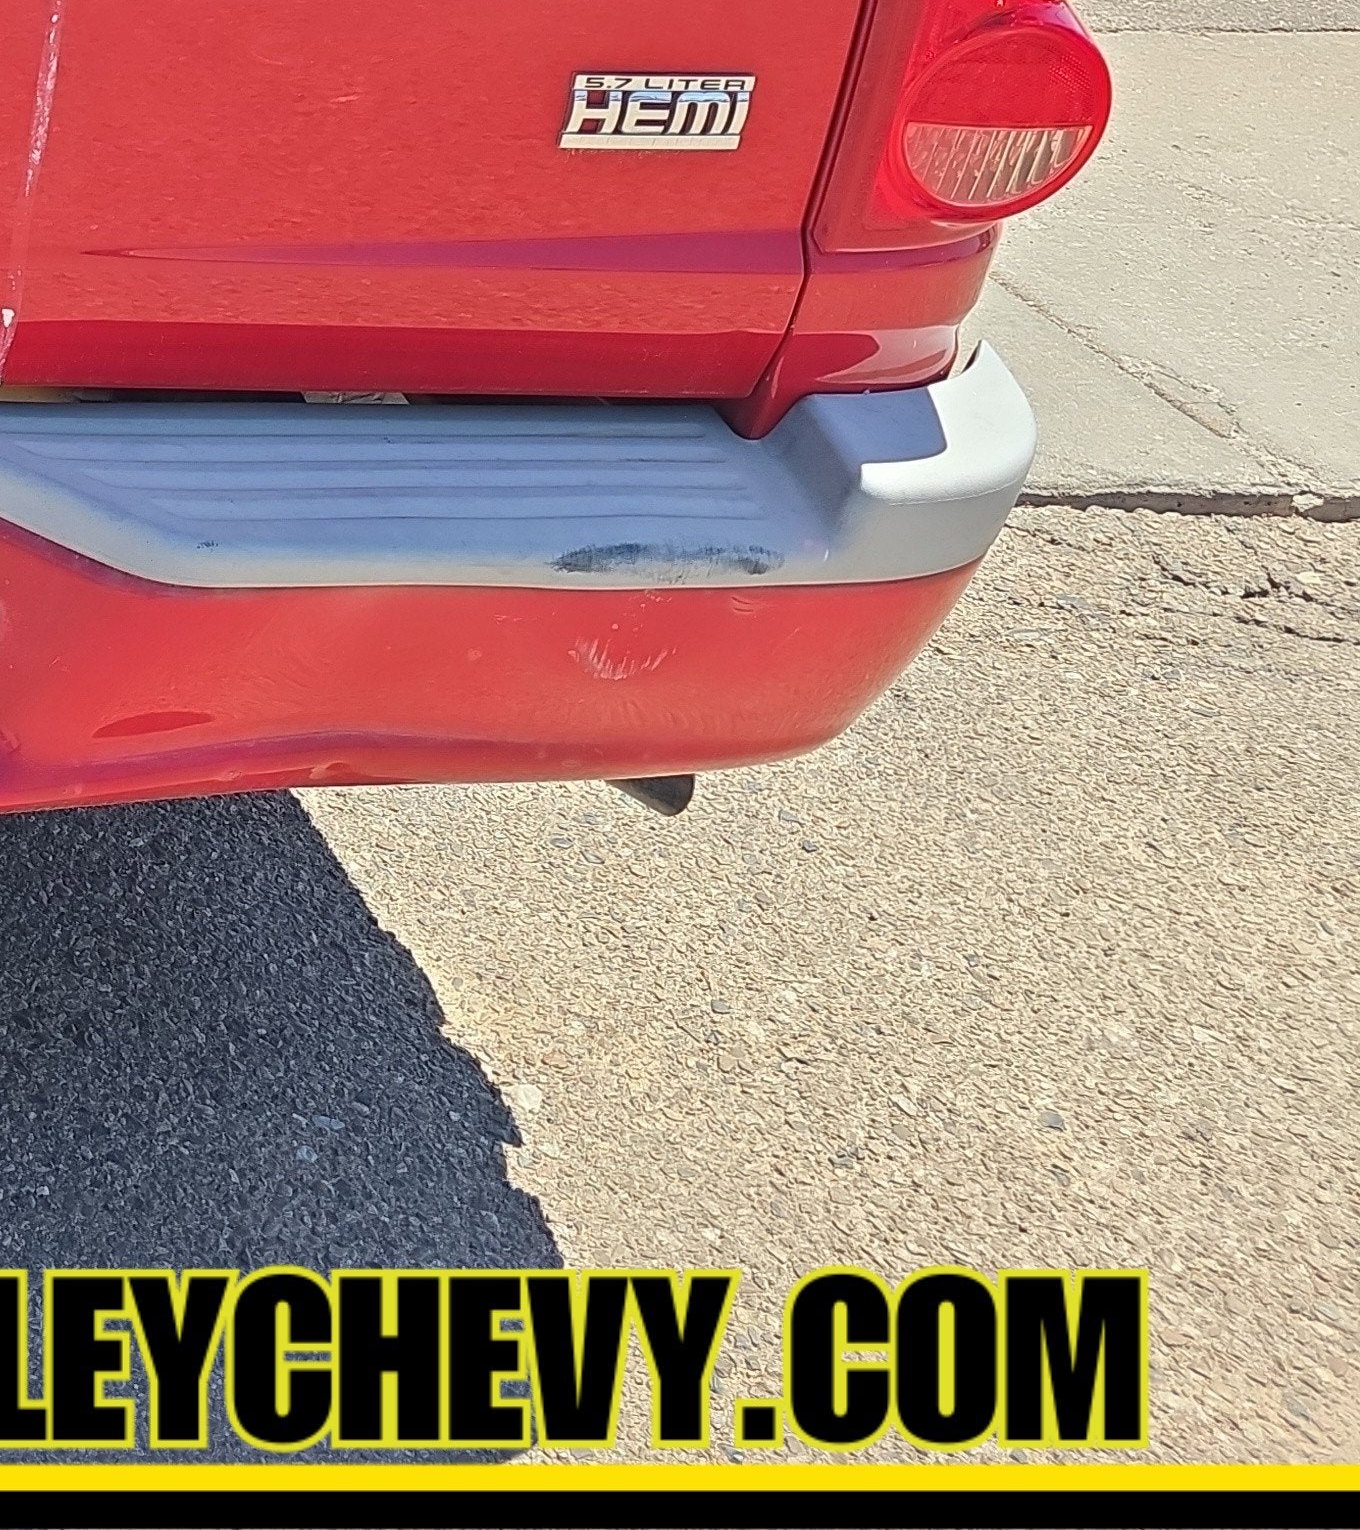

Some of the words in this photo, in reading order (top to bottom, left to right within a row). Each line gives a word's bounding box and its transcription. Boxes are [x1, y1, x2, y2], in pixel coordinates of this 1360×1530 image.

[585, 77, 632, 89] 5.7
[644, 78, 746, 90] LITER
[563, 90, 750, 135] HEMI
